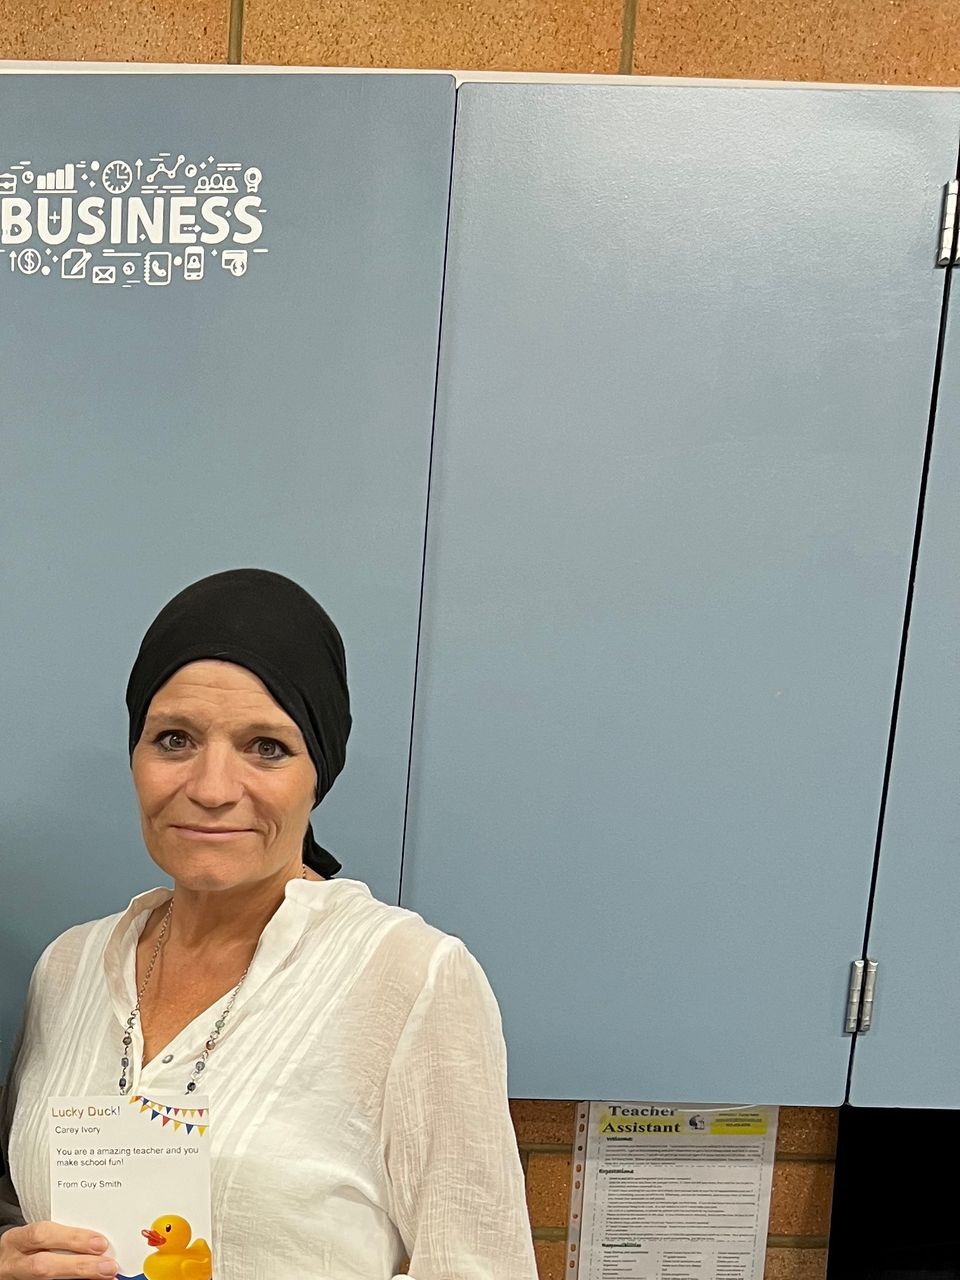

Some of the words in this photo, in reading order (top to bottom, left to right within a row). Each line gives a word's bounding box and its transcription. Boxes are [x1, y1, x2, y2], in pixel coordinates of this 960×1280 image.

[1, 197, 263, 245] BUSINESS
[52, 1107, 83, 1119] Lucky
[88, 1106, 121, 1116] Duck!
[608, 1105, 677, 1117] Teacher
[55, 1126, 79, 1134] Carey
[81, 1126, 100, 1134] Ivory
[602, 1122, 681, 1133] Assistant
[97, 1148, 131, 1156] amazing
[183, 1148, 199, 1156] you
[108, 1158, 124, 1166] fun!
[81, 1180, 97, 1189] Guy
[99, 1180, 122, 1188] Smith
